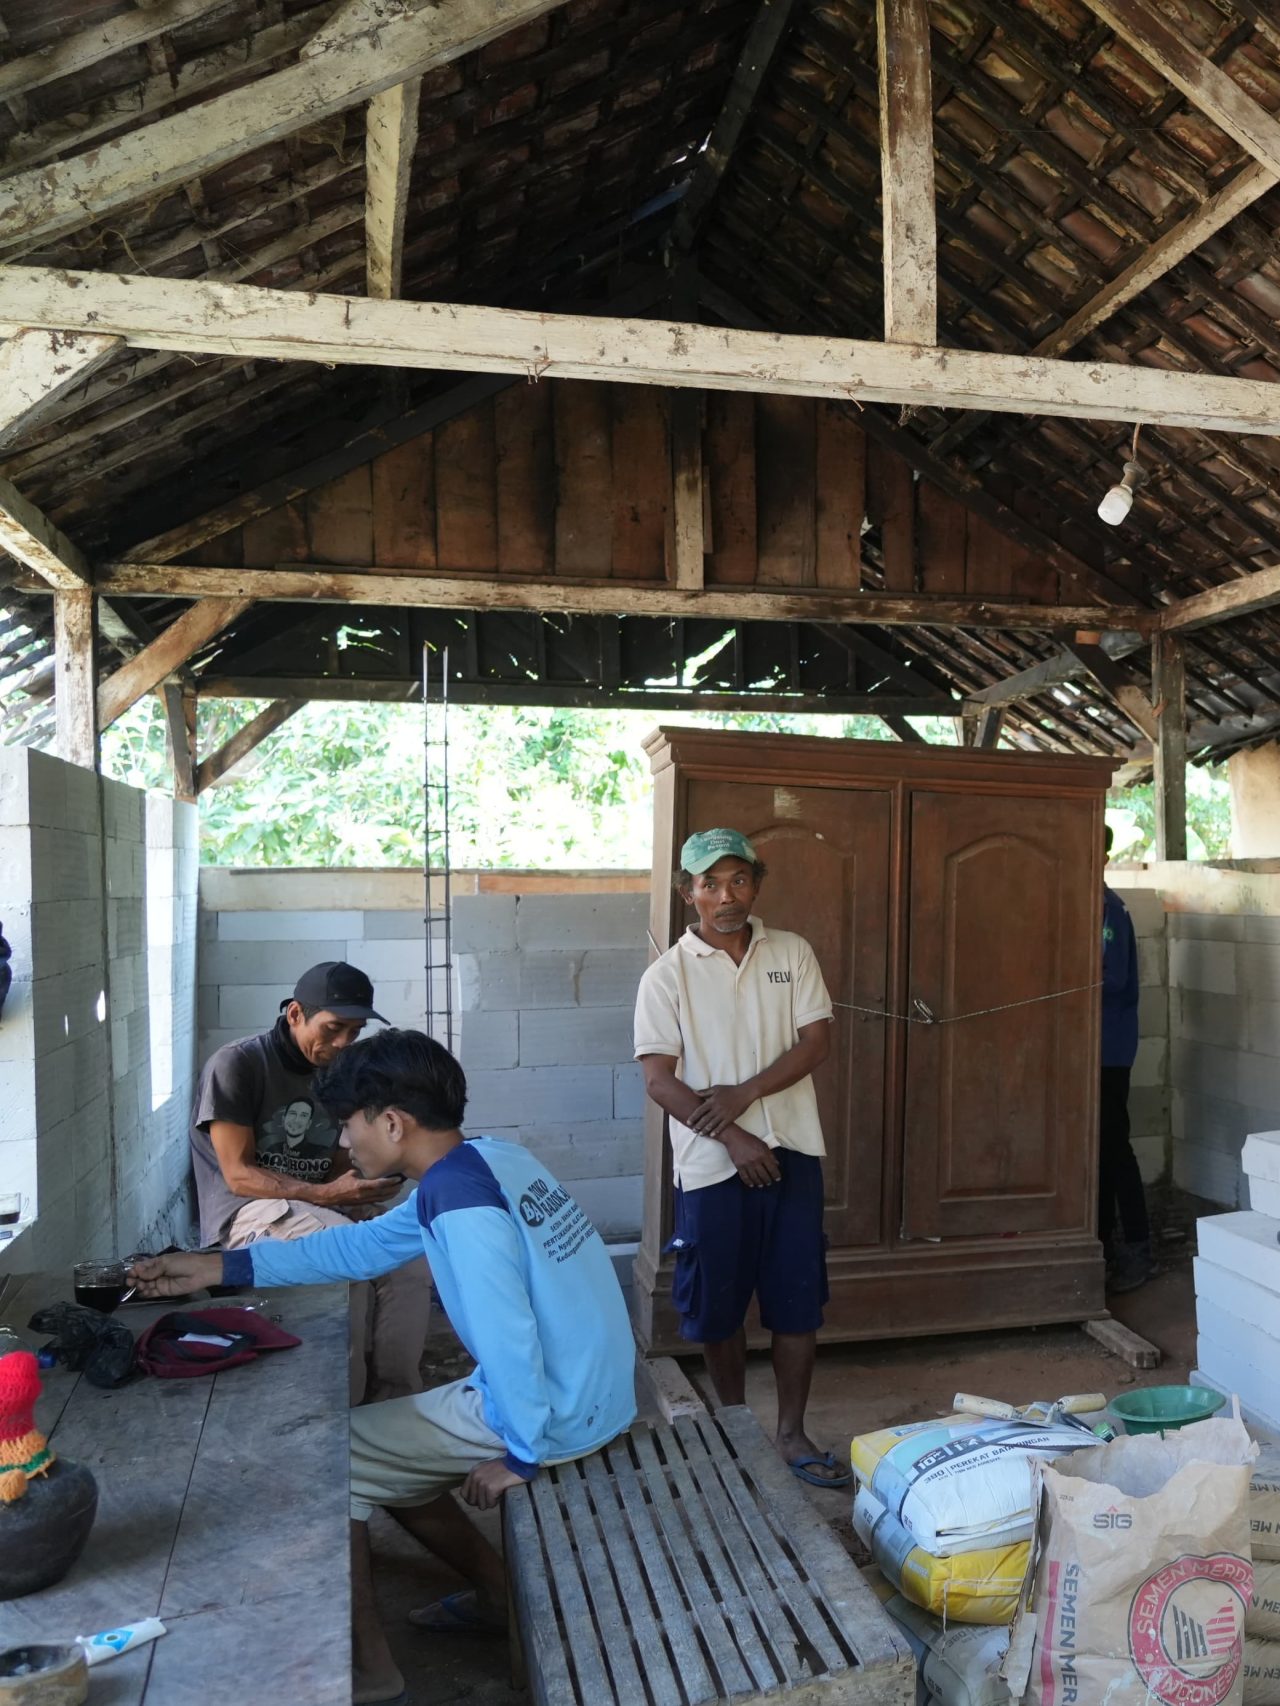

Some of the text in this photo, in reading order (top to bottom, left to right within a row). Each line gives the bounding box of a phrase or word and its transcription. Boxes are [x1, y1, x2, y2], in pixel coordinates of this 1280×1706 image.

[949, 1452, 990, 1471] PEREKAT
[1092, 1511, 1133, 1530] SIG
[1059, 1562, 1080, 1649] SEMEN
[1137, 1561, 1253, 1634] SEMEN MERDE
[1059, 1654, 1078, 1706] MER
